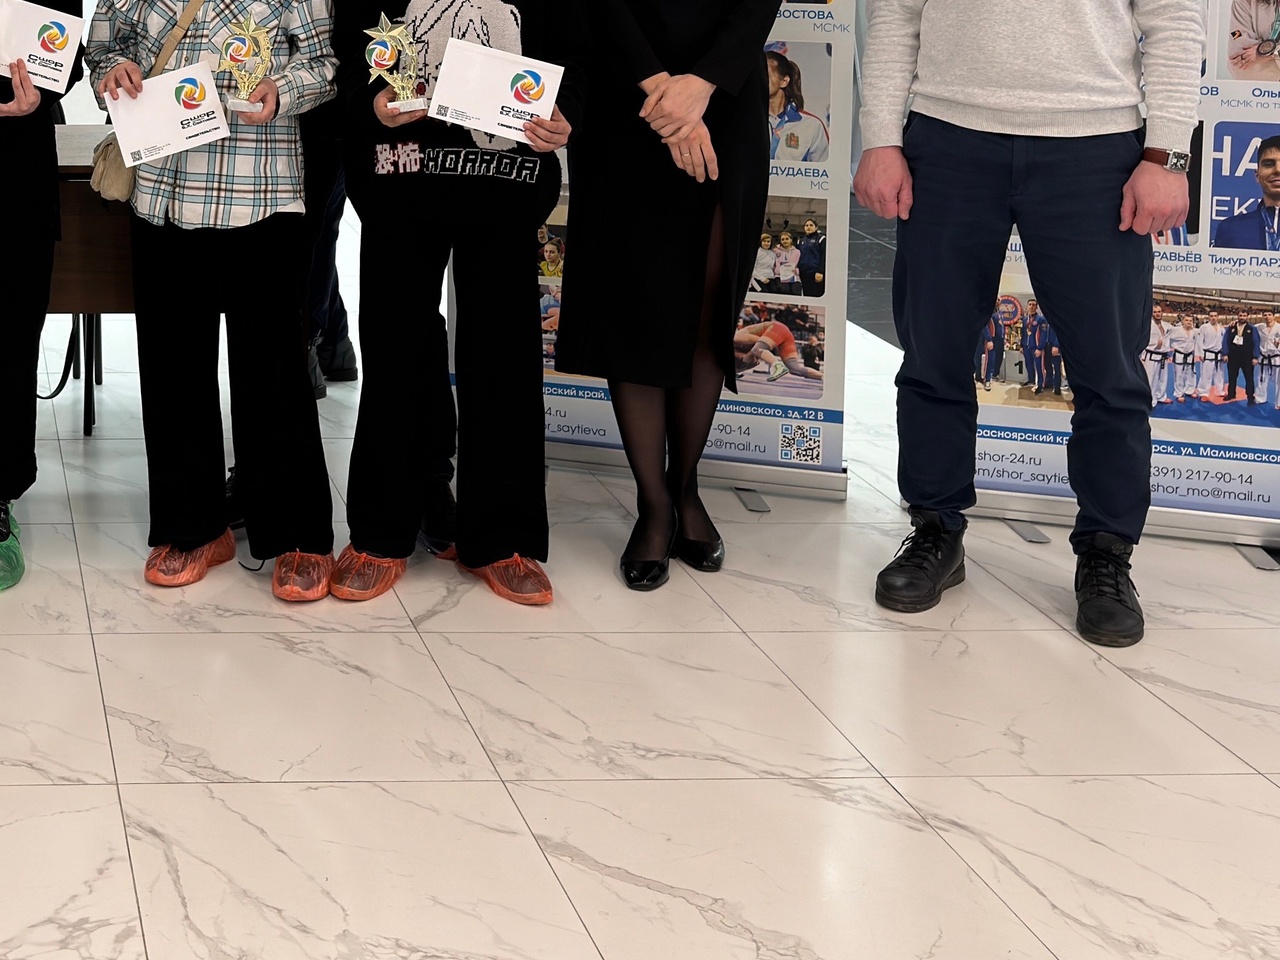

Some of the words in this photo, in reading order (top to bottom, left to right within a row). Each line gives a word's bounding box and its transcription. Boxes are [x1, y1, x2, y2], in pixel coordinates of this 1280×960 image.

[812, 22, 851, 34] МСМК
[1220, 99, 1253, 109] МСМК
[1255, 102, 1270, 110] по
[424, 148, 541, 184] HORROR
[769, 165, 829, 179] ДУДАЕВА
[810, 180, 829, 191] МС
[1208, 253, 1247, 268] Тимур
[1175, 264, 1198, 274] ИТФ
[1213, 267, 1246, 278] МСМК
[1248, 270, 1263, 278] по
[577, 388, 608, 401] край,
[1180, 447, 1197, 459] ул.
[1185, 468, 1254, 486] 217-90-14
